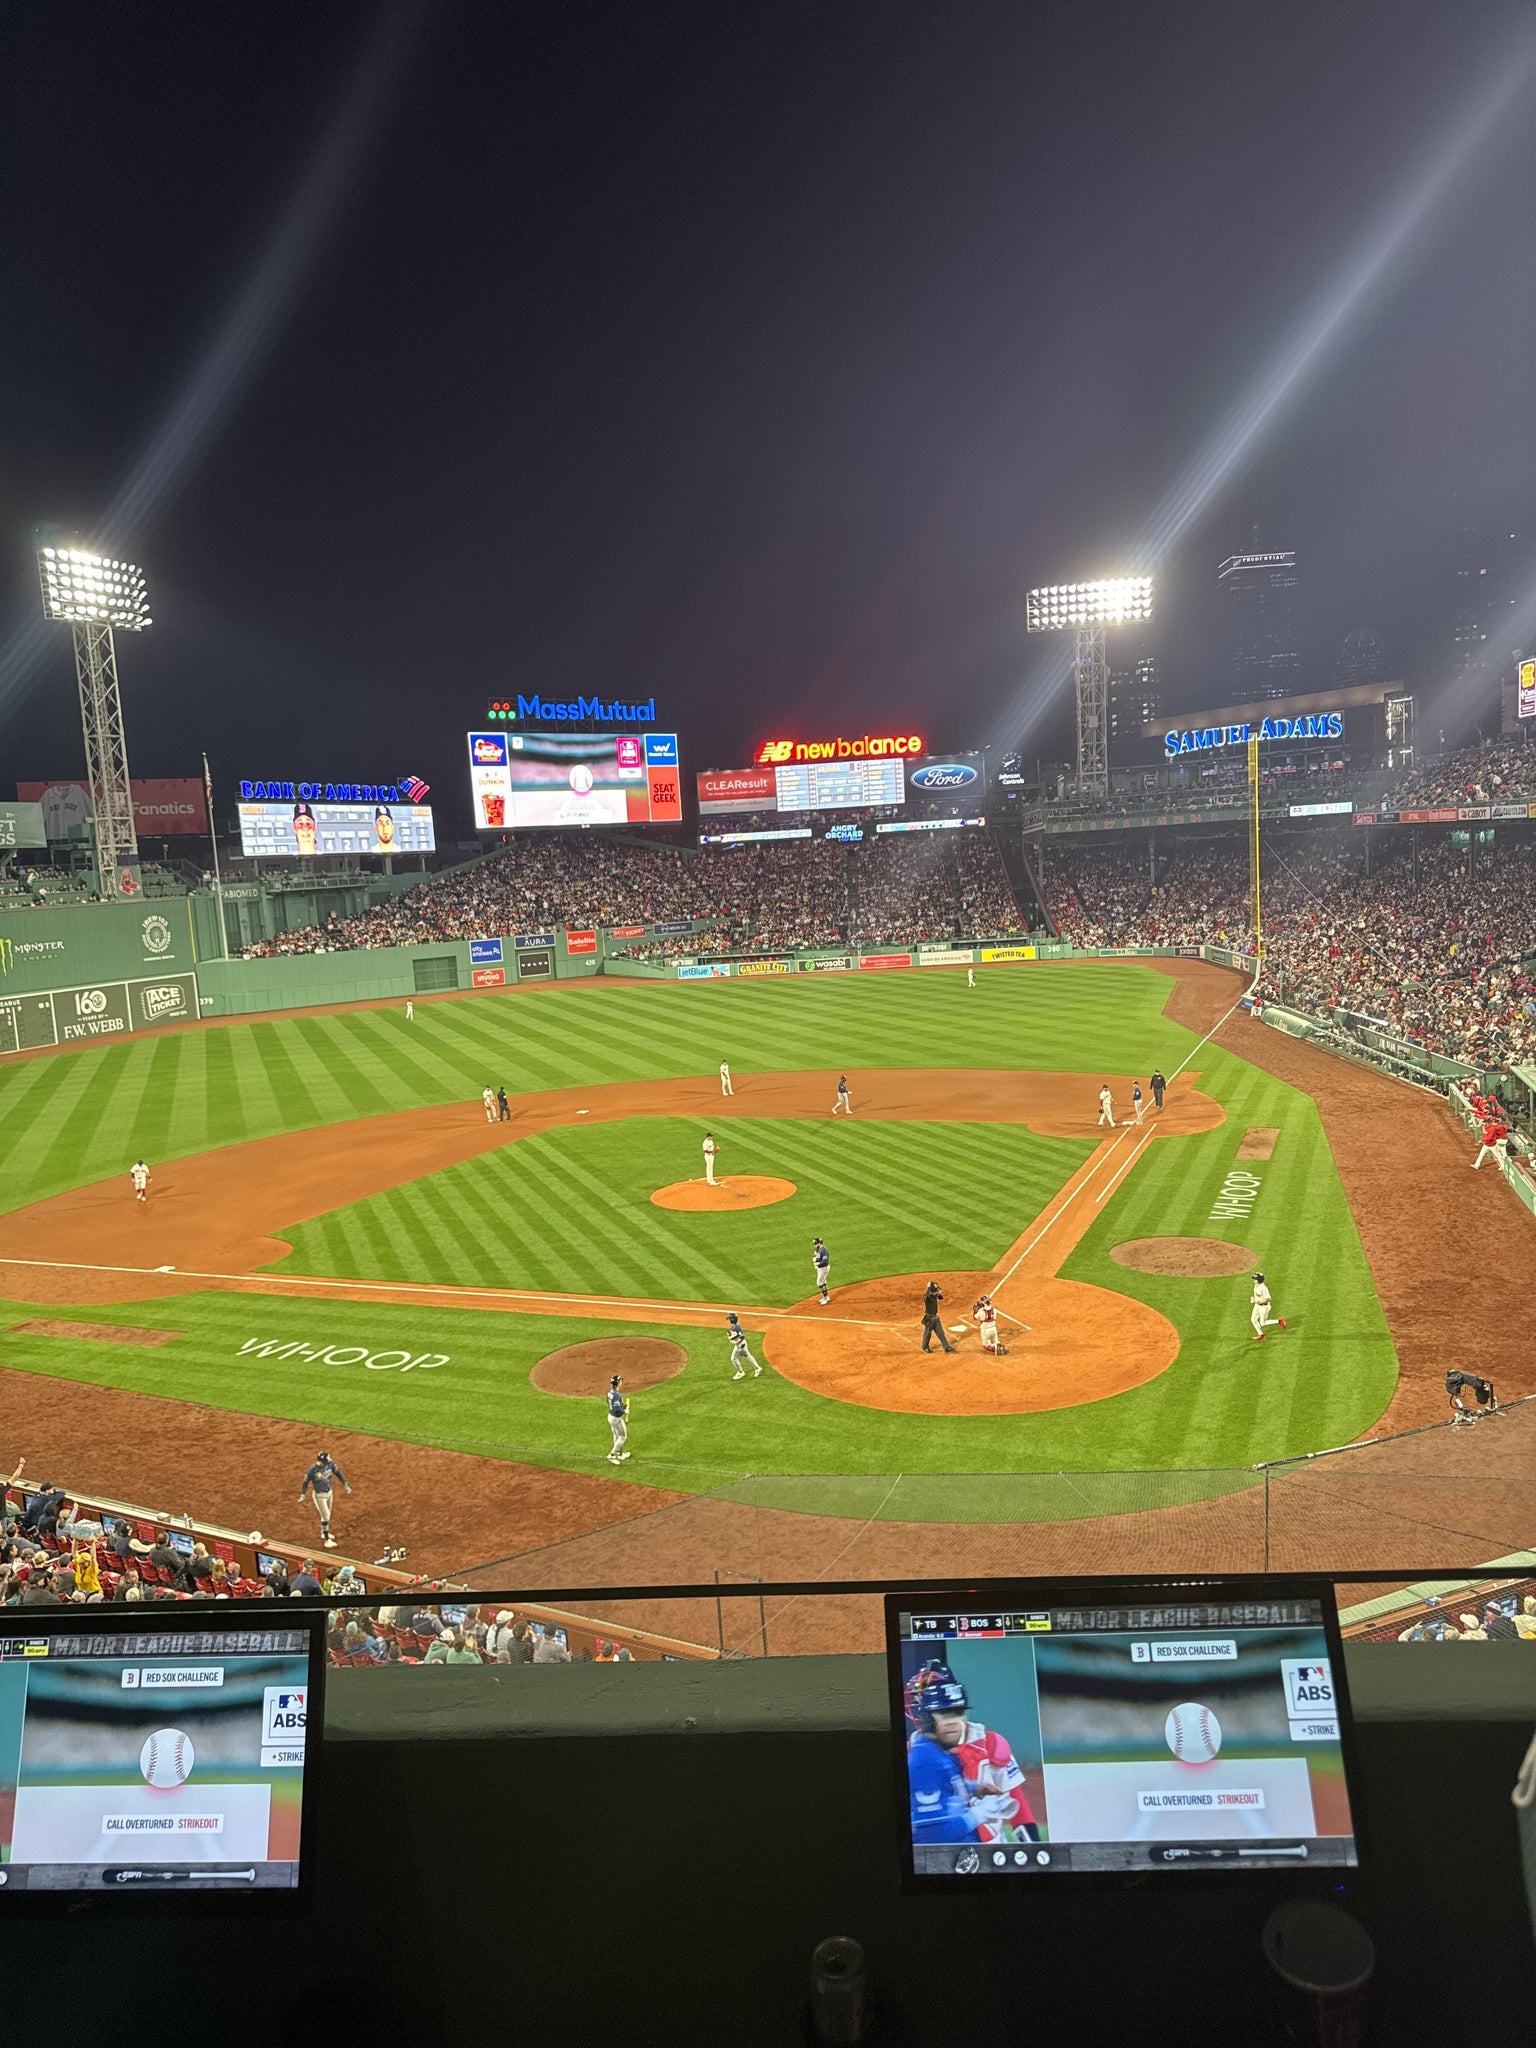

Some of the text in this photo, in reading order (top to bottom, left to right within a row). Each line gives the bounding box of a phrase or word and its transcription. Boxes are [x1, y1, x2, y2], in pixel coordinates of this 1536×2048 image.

[518, 694, 656, 721] MassMutual
[1164, 712, 1343, 758] SAMUEL ADAMS
[923, 768, 963, 786] Ford
[240, 780, 399, 802] BANK OF AMERICA
[653, 783, 674, 793] SEAT
[705, 778, 768, 791] CLEAResult
[653, 793, 677, 803] GEEK
[132, 801, 195, 816] Fanatics
[825, 830, 864, 839] ORCHARD
[831, 824, 858, 832] ANGRY
[224, 888, 259, 899] ABIOMED
[14, 941, 65, 954] MONSTER
[991, 950, 1026, 960] TWISTED TEA
[740, 962, 788, 975] GRANITE CITY
[816, 958, 846, 968] wasabi
[477, 973, 500, 982] IRVING
[682, 967, 708, 978] jetBlue
[149, 987, 181, 1003] ACE
[75, 990, 107, 1016] 160
[151, 998, 181, 1013] TICKET
[63, 1017, 124, 1039] F.W. WEBB
[1208, 1171, 1263, 1219] WHOOP
[235, 1337, 450, 1373] WHOOP
[924, 1620, 937, 1629] TB
[949, 1619, 956, 1629] 3
[970, 1619, 989, 1628] BOS
[995, 1618, 1003, 1627] 3
[1057, 1605, 1310, 1630] MAJOR LEAGUE BASEBALL
[54, 1633, 297, 1656] MAJOR LEAGUE BASEBALL
[1156, 1645, 1231, 1656] RED SOX CHALLENGE
[1137, 1646, 1145, 1658] B
[127, 1672, 134, 1684] B
[146, 1671, 219, 1683] RED SOX CHALLENGE
[1296, 1685, 1332, 1701] ABS
[273, 1713, 307, 1728] ABS
[1307, 1725, 1336, 1736] STRIKE
[277, 1751, 304, 1762] STRIKE
[1142, 1793, 1259, 1806] CALL OVERTURNED STRIKEOUT
[106, 1818, 219, 1830] CALL OVERTURNED STRIKEOUT
